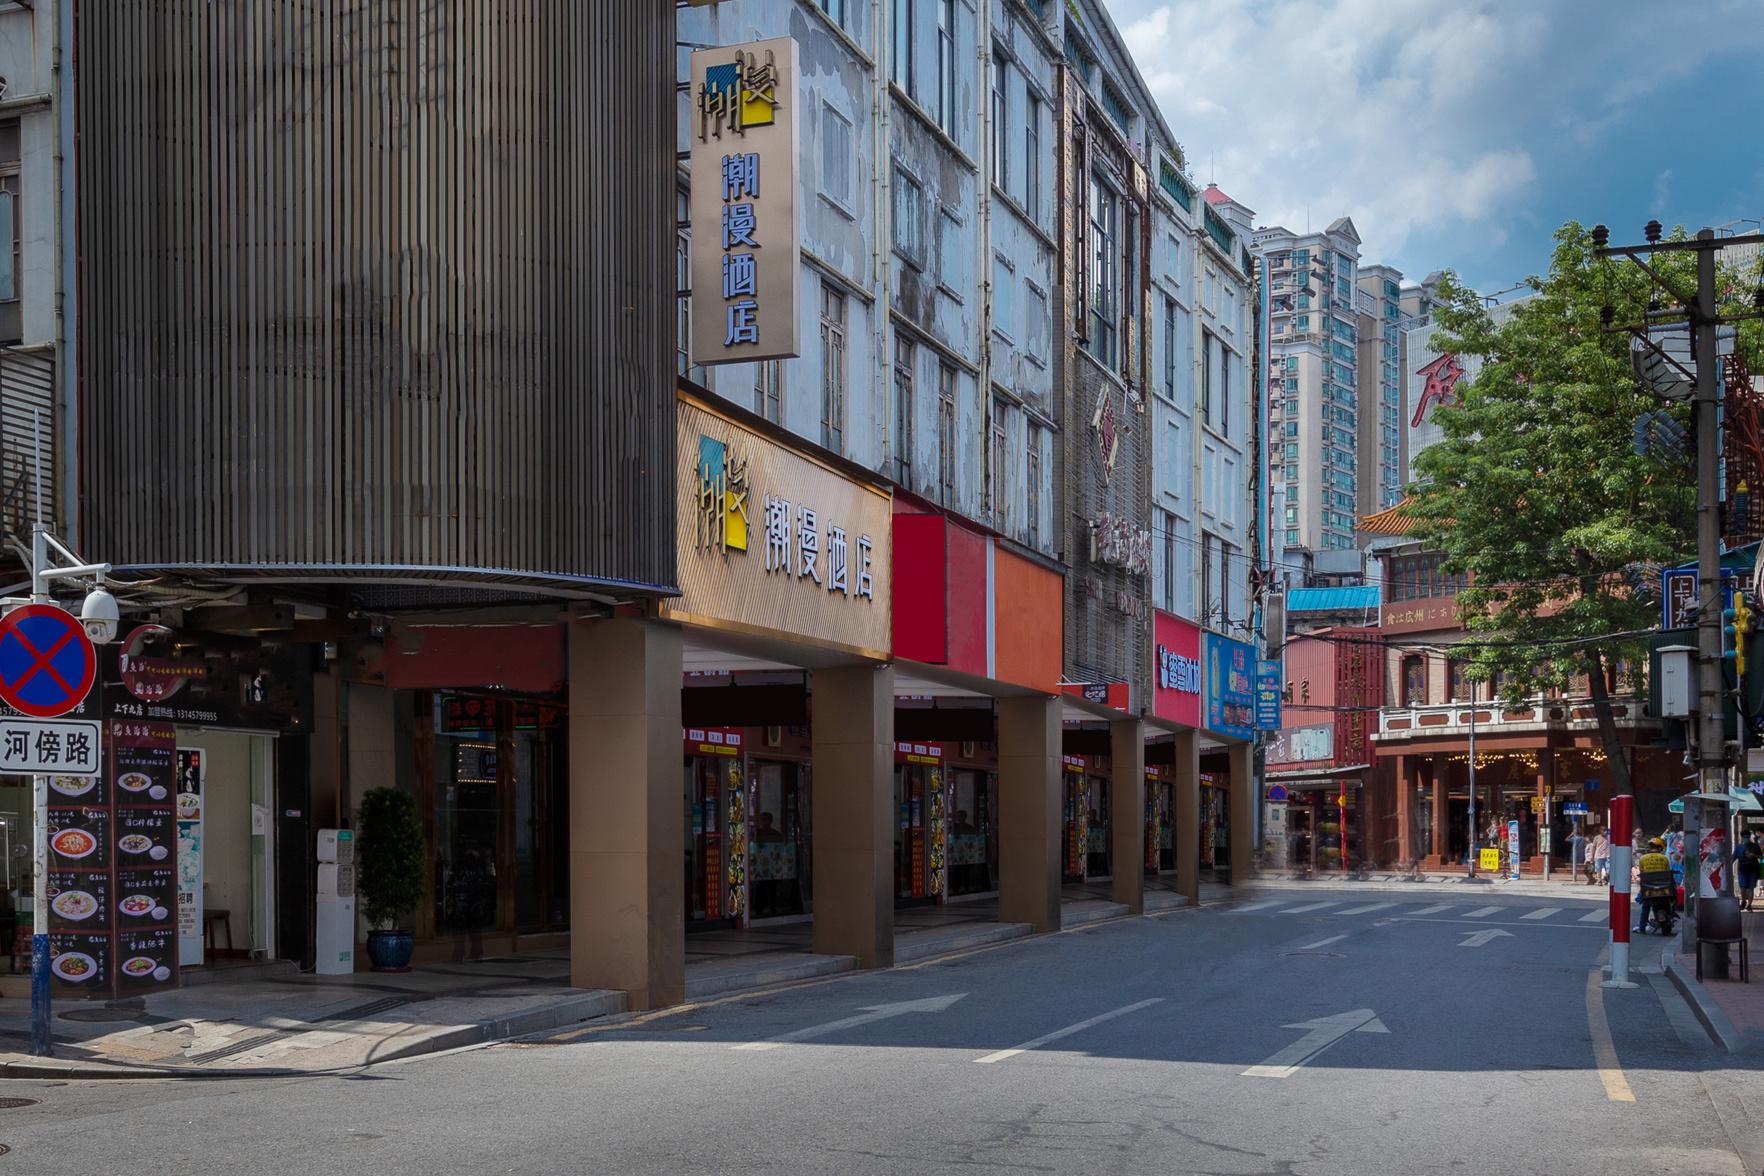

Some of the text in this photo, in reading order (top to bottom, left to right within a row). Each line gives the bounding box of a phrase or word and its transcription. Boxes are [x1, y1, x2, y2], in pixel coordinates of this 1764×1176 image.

[722, 152, 762, 347] 潮漫酒店
[765, 490, 873, 602] 潮漫酒店
[4, 729, 91, 765] 河傍路
